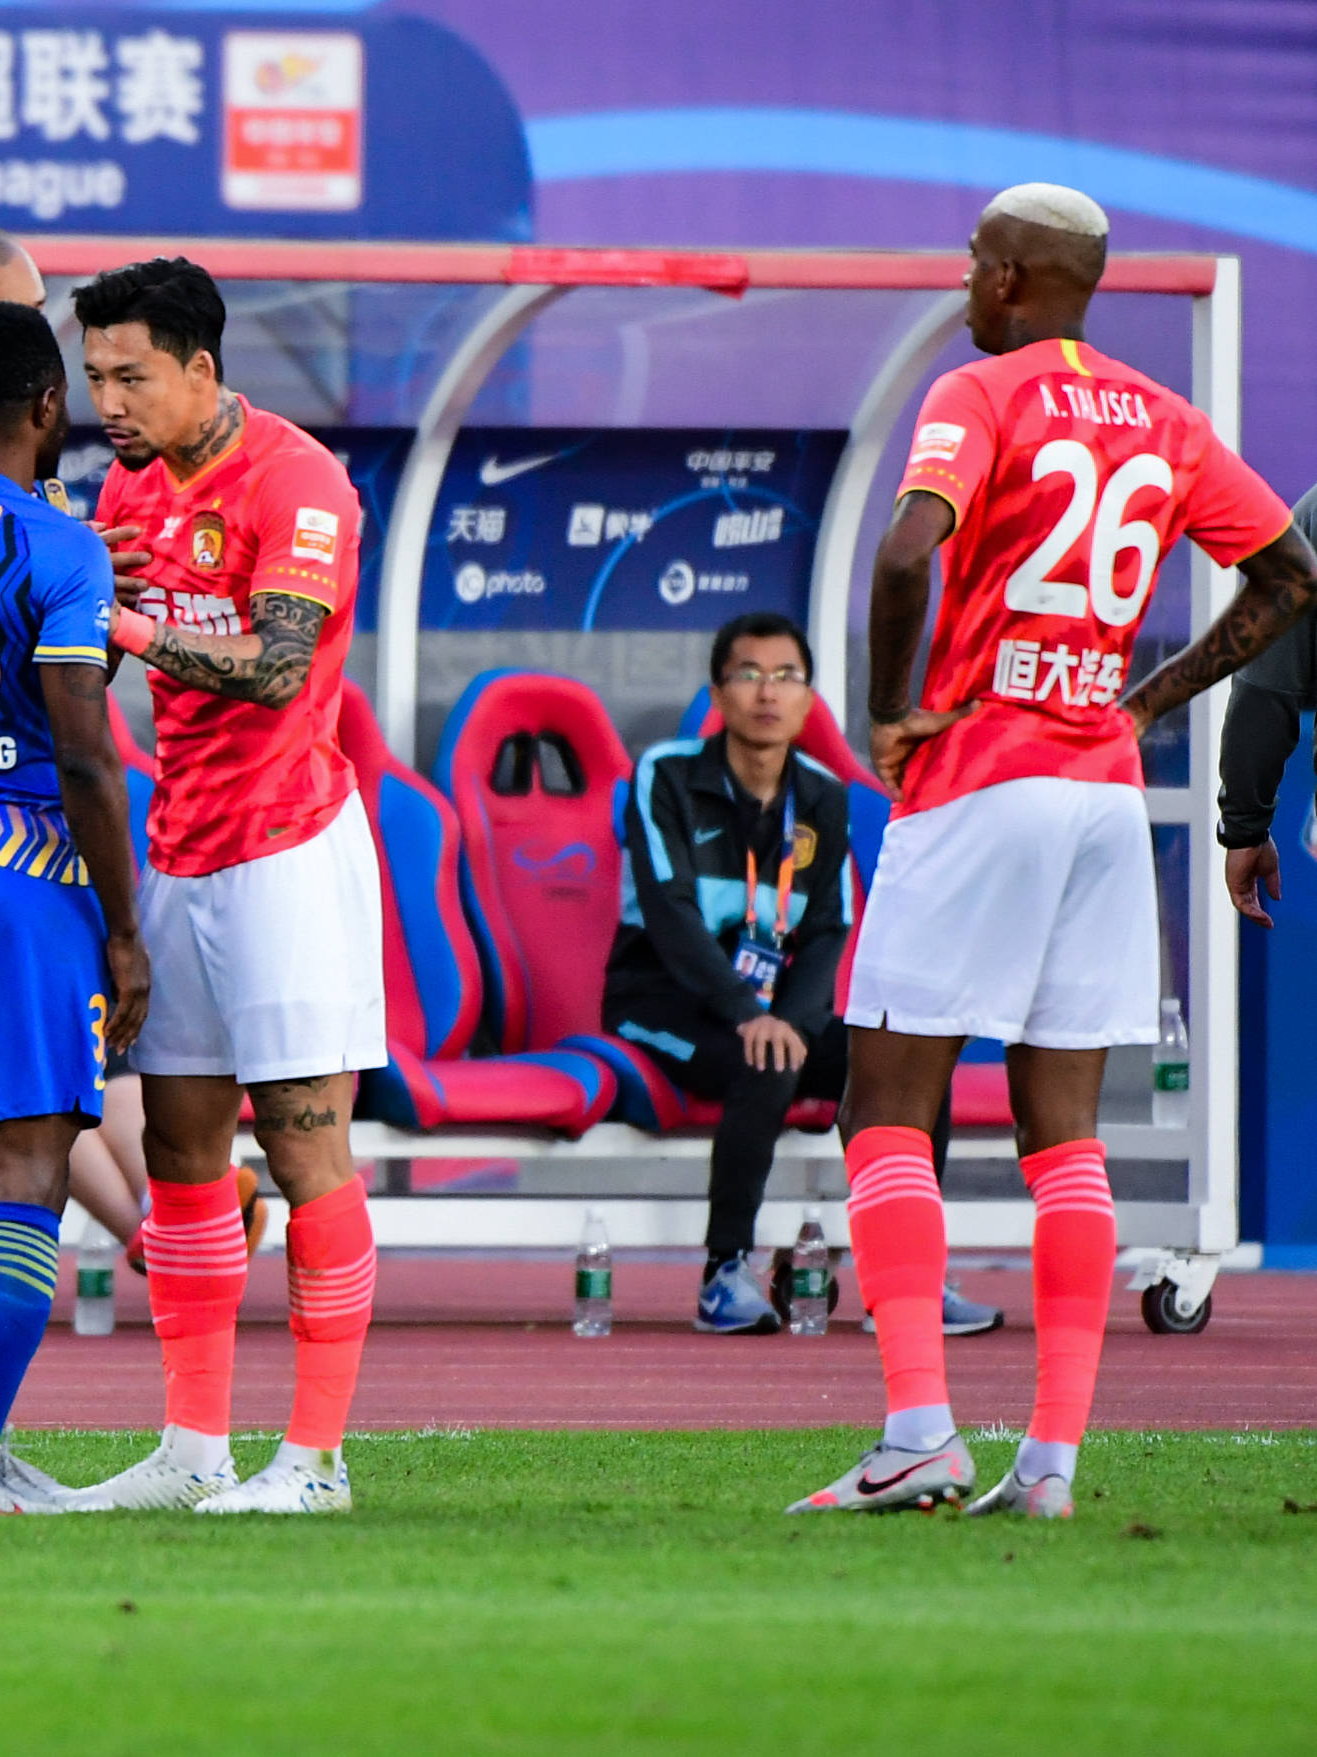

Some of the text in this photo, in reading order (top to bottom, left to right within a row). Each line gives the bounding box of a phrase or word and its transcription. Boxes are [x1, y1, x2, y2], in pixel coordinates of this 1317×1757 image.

[446, 507, 506, 544] 天猫
[1004, 438, 1174, 627] 26
[486, 570, 545, 598] photo
